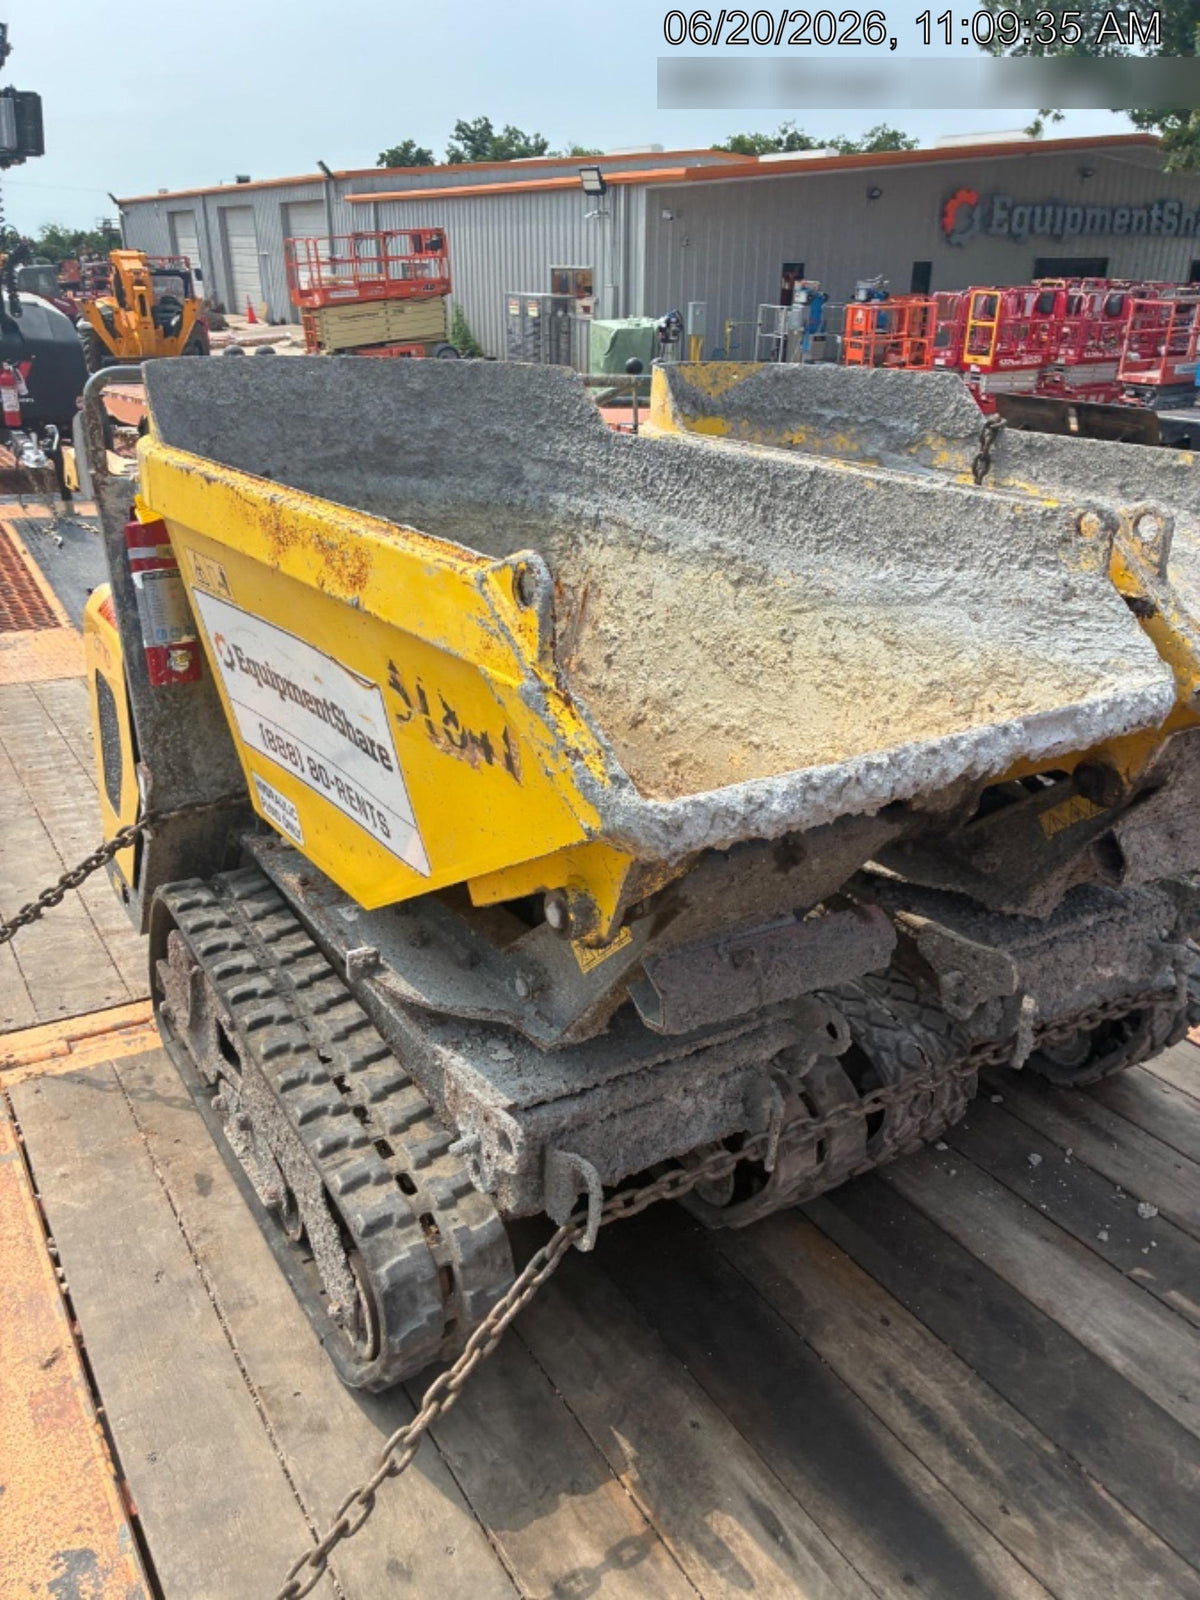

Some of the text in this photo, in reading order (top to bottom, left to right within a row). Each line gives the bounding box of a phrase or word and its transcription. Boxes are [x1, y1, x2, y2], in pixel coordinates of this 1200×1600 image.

[232, 643, 393, 772] EquipmentShare
[258, 722, 391, 839] (888) 80-RENTS
